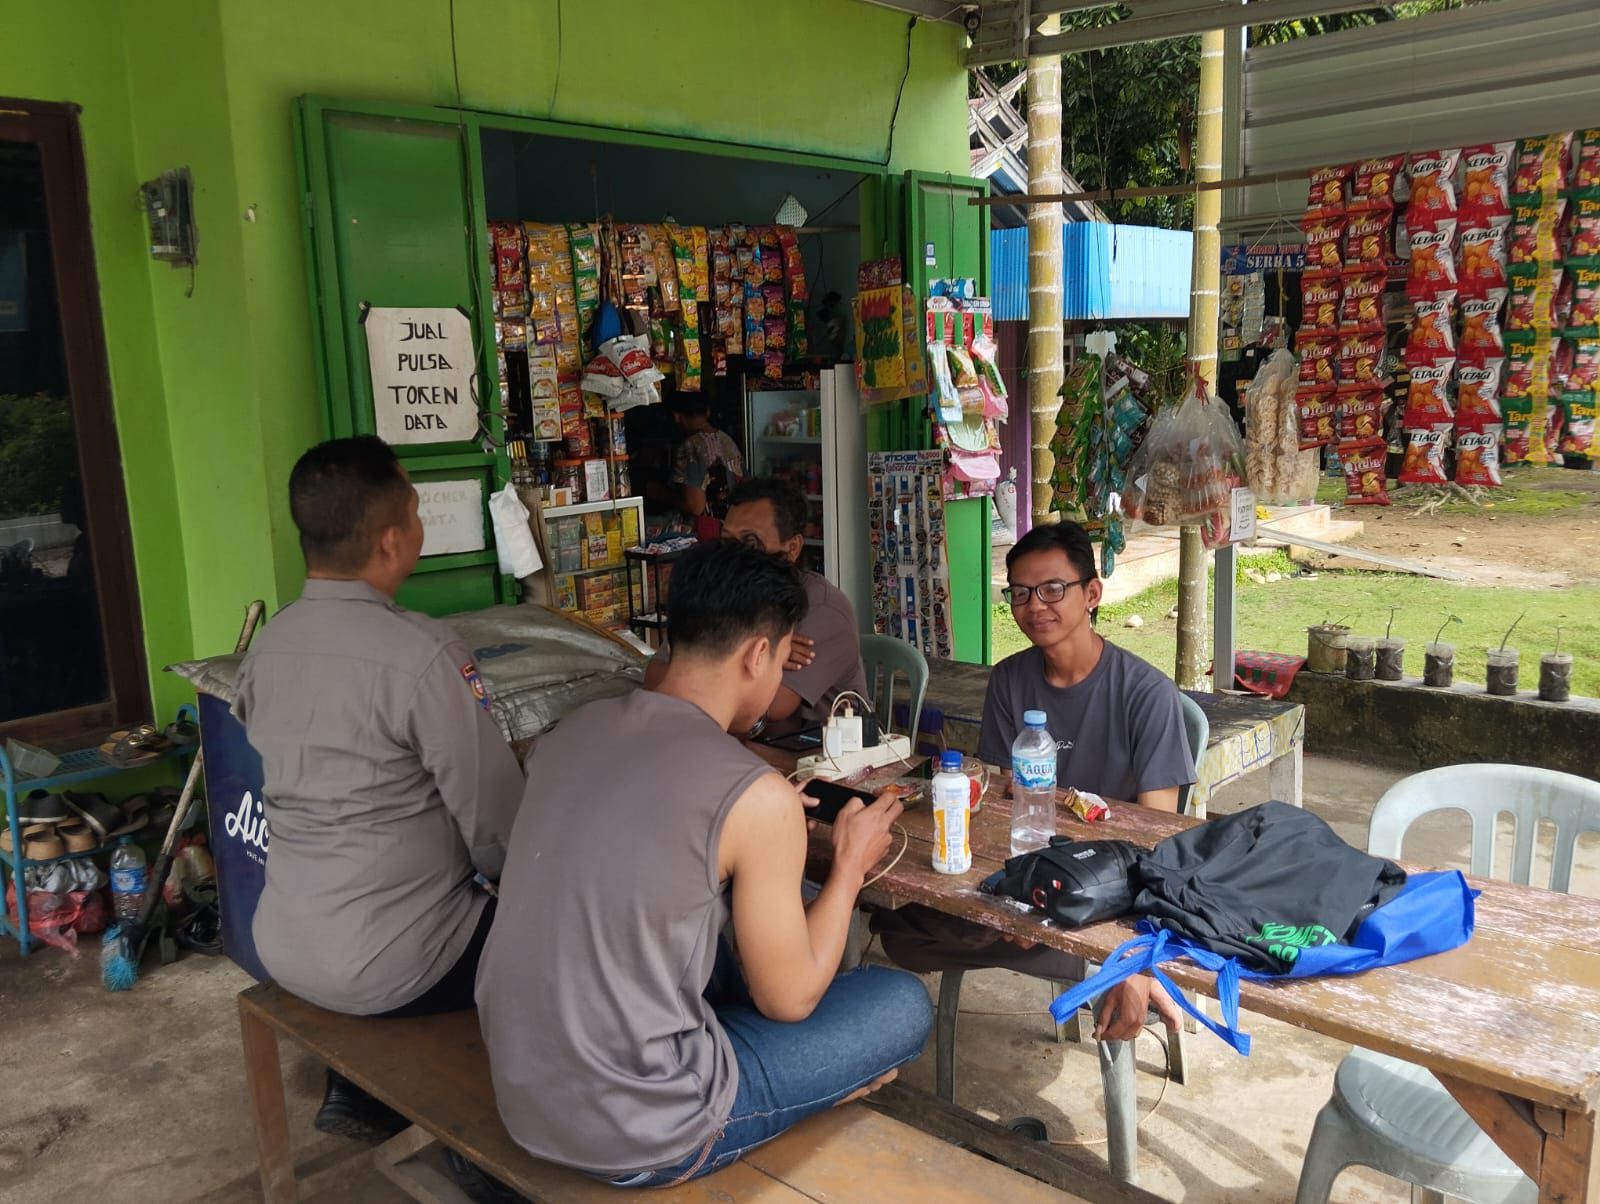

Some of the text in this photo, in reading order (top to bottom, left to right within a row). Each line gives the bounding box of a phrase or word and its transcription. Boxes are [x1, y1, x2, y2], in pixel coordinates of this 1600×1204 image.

[1412, 160, 1448, 175] KETAGI
[1467, 155, 1504, 169] KETAGI
[1463, 229, 1499, 243] KETAGI
[1246, 255, 1292, 268] SERBA
[399, 318, 449, 341] JUAL
[398, 353, 453, 371] PULSA
[387, 385, 458, 405] TOKEN
[404, 414, 448, 430] DATA
[1026, 764, 1053, 776] AQUA
[225, 790, 269, 853] Aic
